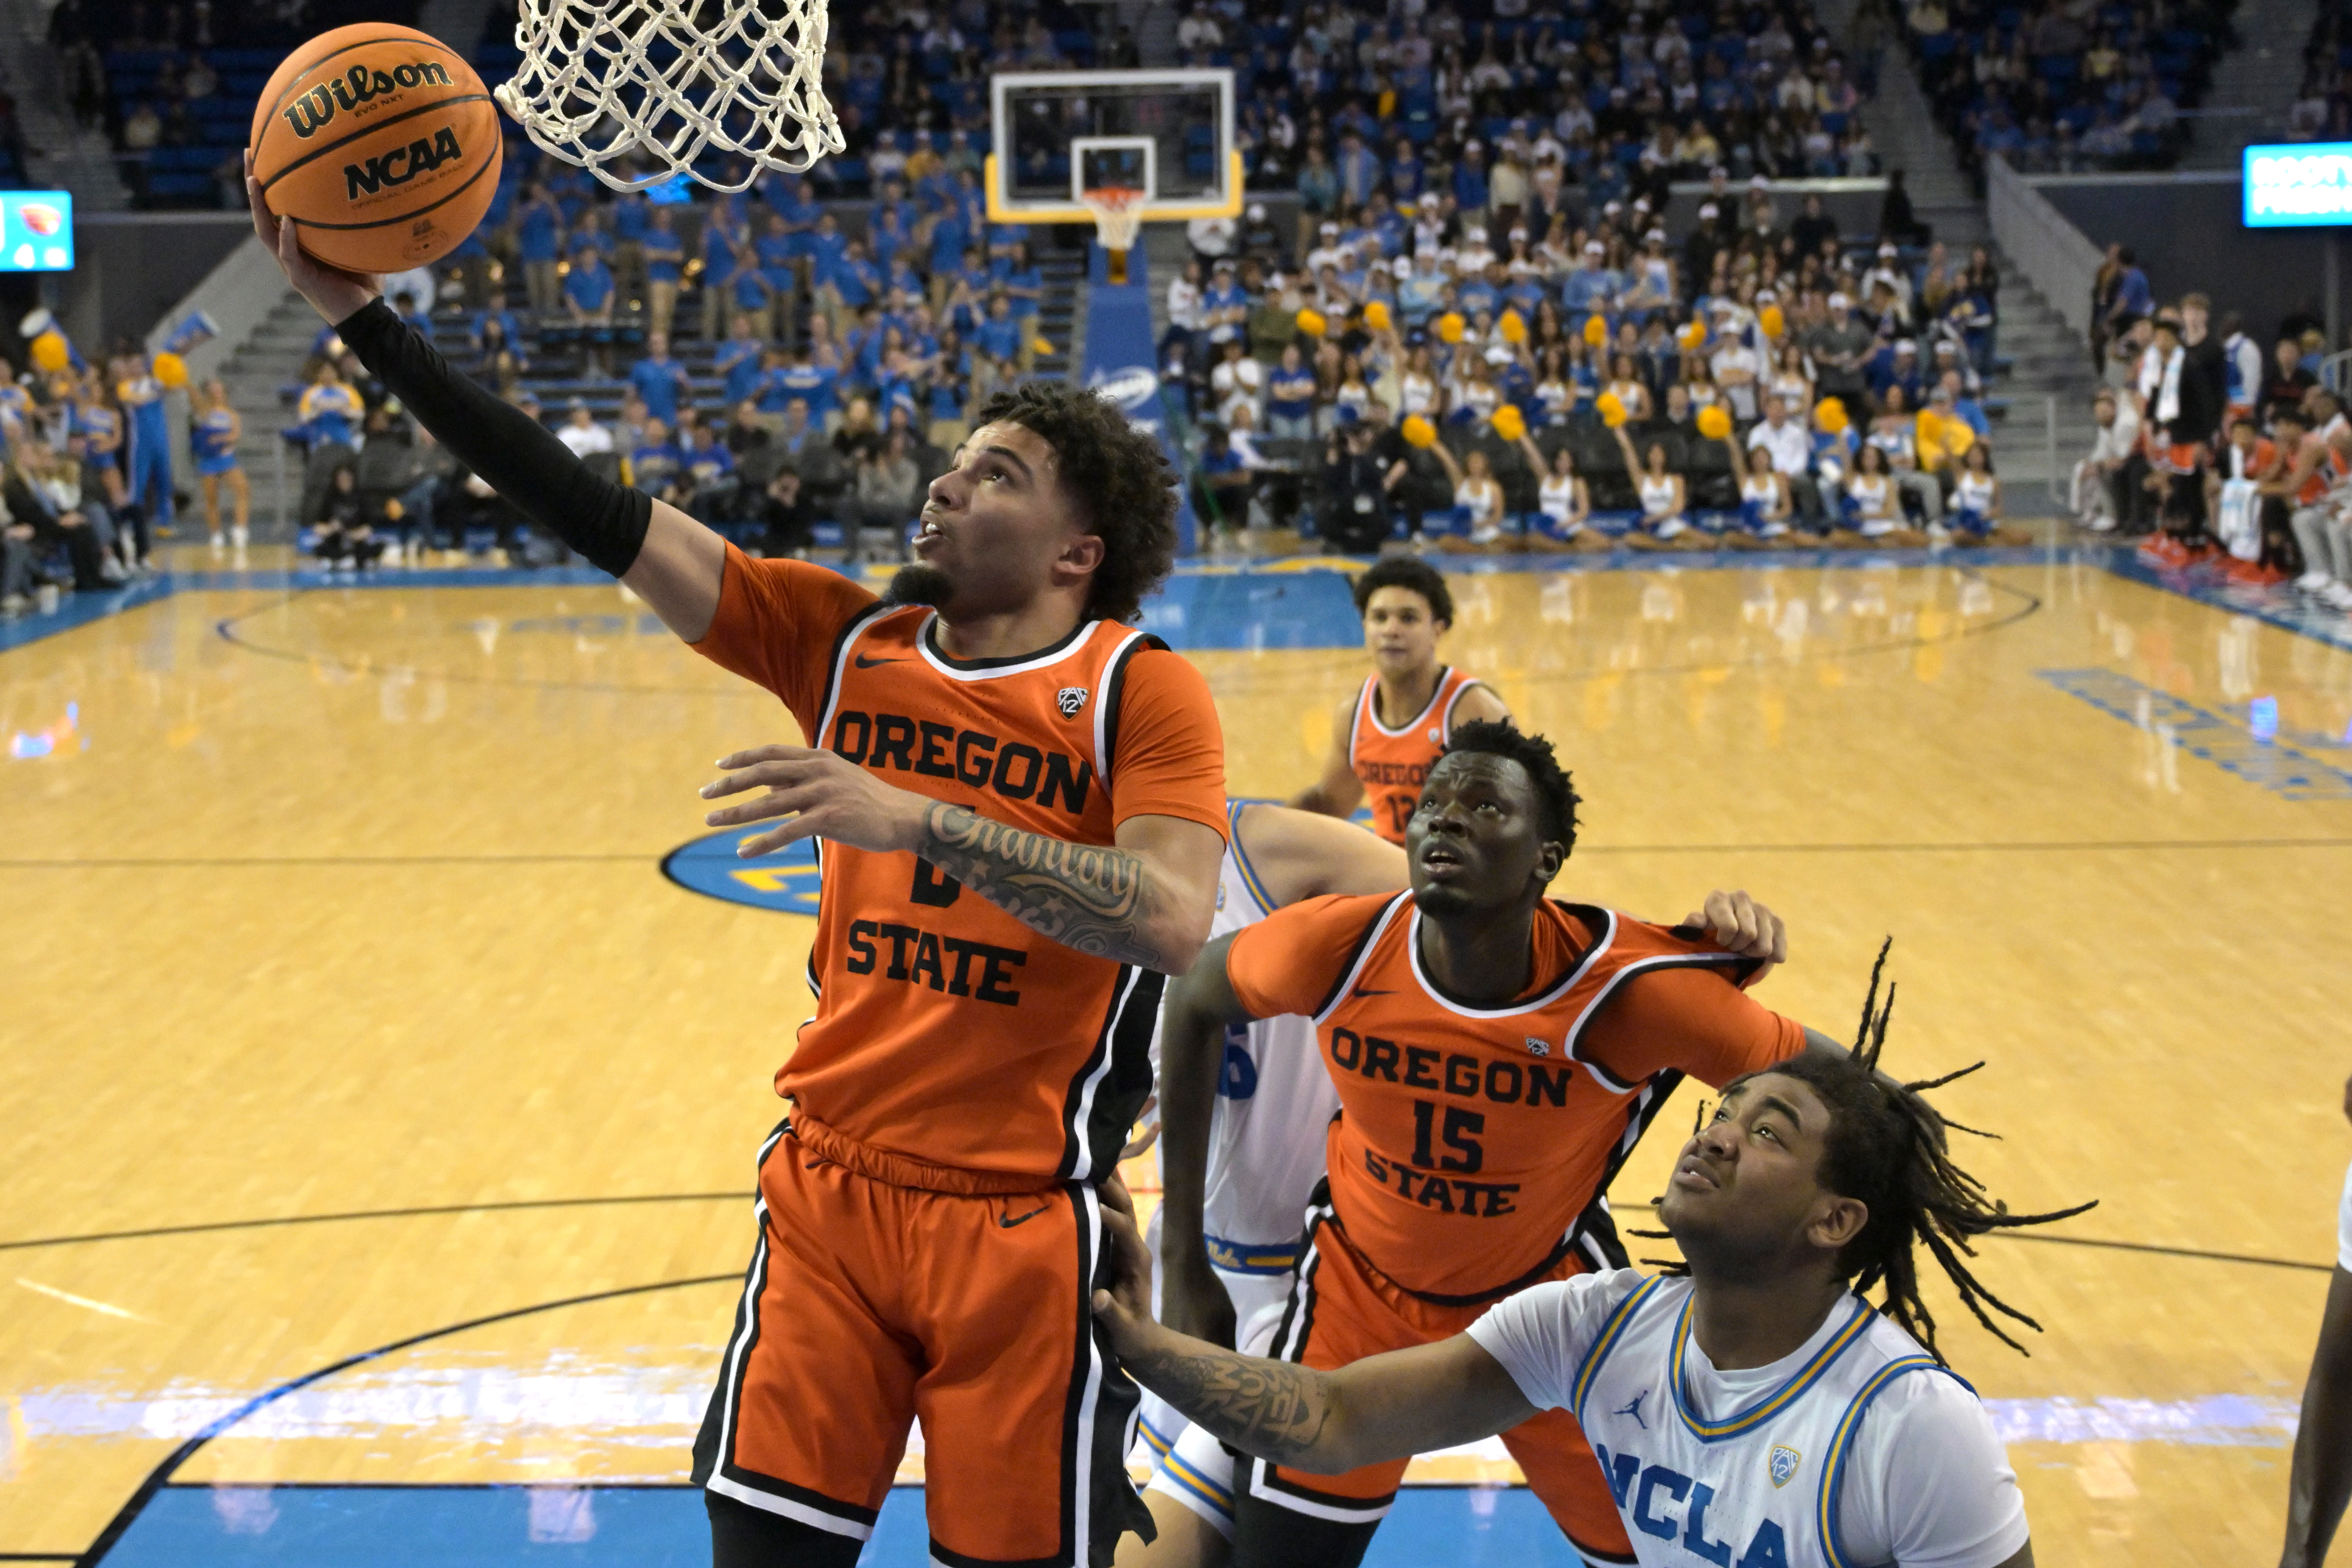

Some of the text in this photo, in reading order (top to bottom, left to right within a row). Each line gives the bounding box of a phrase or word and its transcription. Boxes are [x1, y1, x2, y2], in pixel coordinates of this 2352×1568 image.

[283, 62, 454, 139] Wilson
[344, 126, 462, 201] NCAA
[1058, 687, 1088, 706] PAC
[1063, 699, 1079, 712] 12
[833, 710, 1092, 814] OREGON
[847, 919, 1027, 1006] STATE
[1331, 1026, 1572, 1106] OREGON
[1411, 1099, 1484, 1173] 15
[1365, 1148, 1520, 1217] STATE
[1771, 1447, 1799, 1474] PAC
[1773, 1464, 1788, 1480] 12
